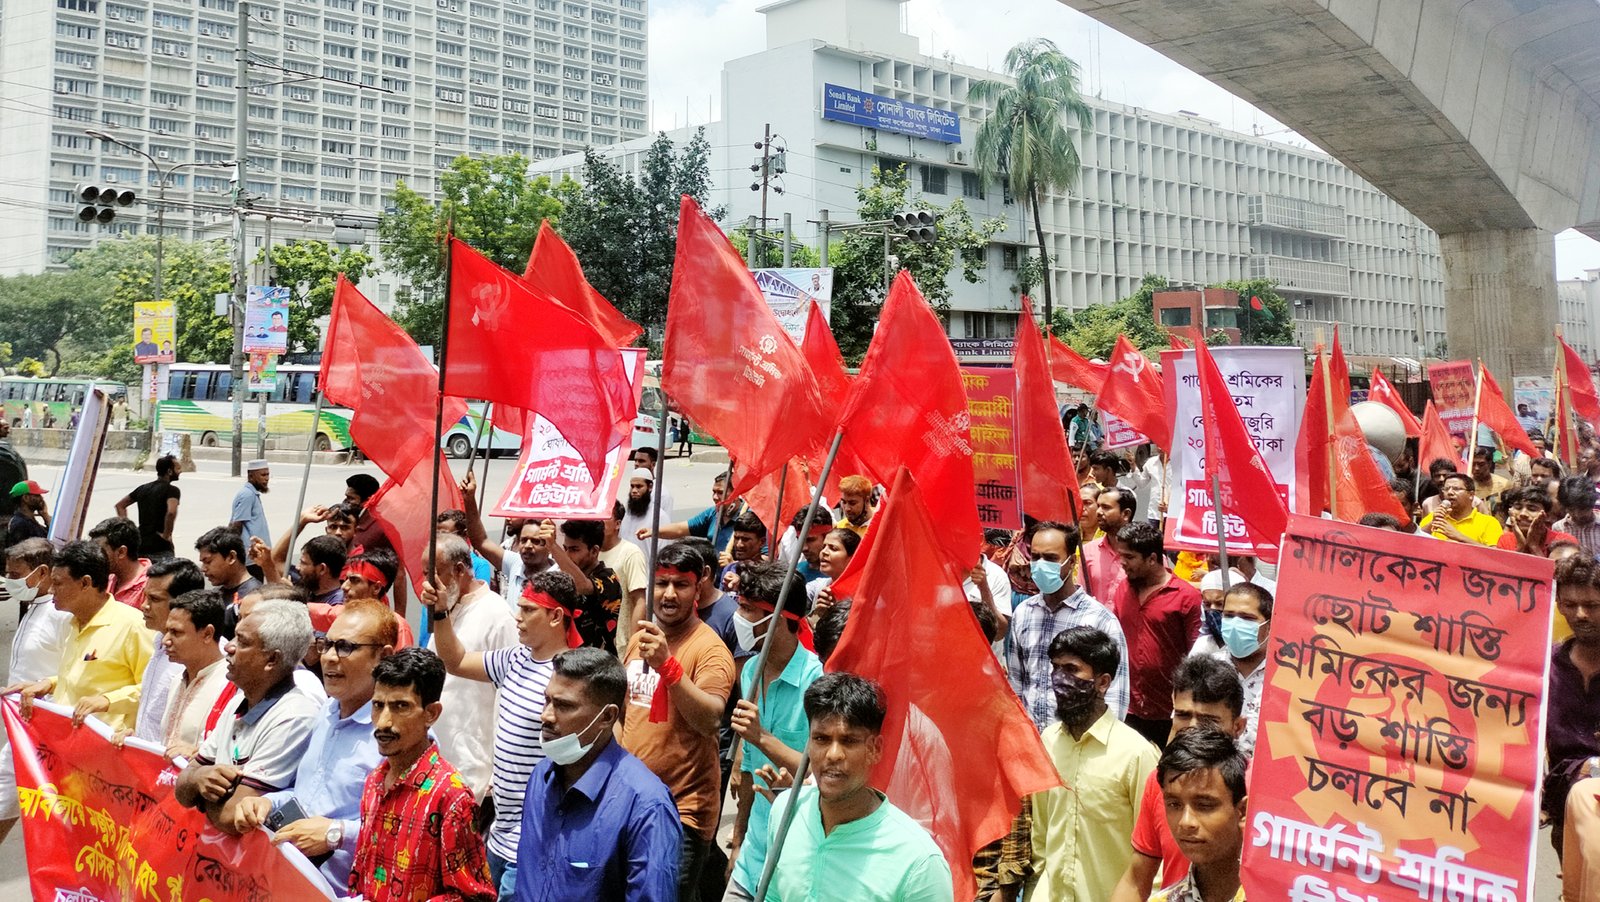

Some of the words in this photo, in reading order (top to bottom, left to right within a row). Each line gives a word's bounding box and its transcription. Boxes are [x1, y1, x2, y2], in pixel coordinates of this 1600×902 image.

[828, 89, 845, 101] Sonali
[846, 92, 861, 104] Bank
[834, 100, 856, 112] Limited
[877, 100, 904, 117] সোনালী
[905, 107, 926, 121] ব্যাংক
[926, 108, 955, 127] লিমিটেড
[1227, 370, 1283, 389] শ্রমিকের
[561, 463, 592, 483] শ্রমি
[1289, 530, 1448, 595] মালিকের
[1458, 565, 1546, 613] জন্য
[1304, 589, 1398, 638] ছোট
[1413, 609, 1508, 661] শাস্তি
[1273, 633, 1433, 704] শ্রমিকের
[1442, 674, 1537, 727] জন্য
[1298, 697, 1366, 750] বড়
[1377, 716, 1475, 770] শাস্তি
[1303, 756, 1416, 819] চলবে
[1425, 785, 1478, 835] না
[1252, 811, 1386, 885] গার্মেন্ট
[1388, 846, 1519, 902] শ্রমিক
